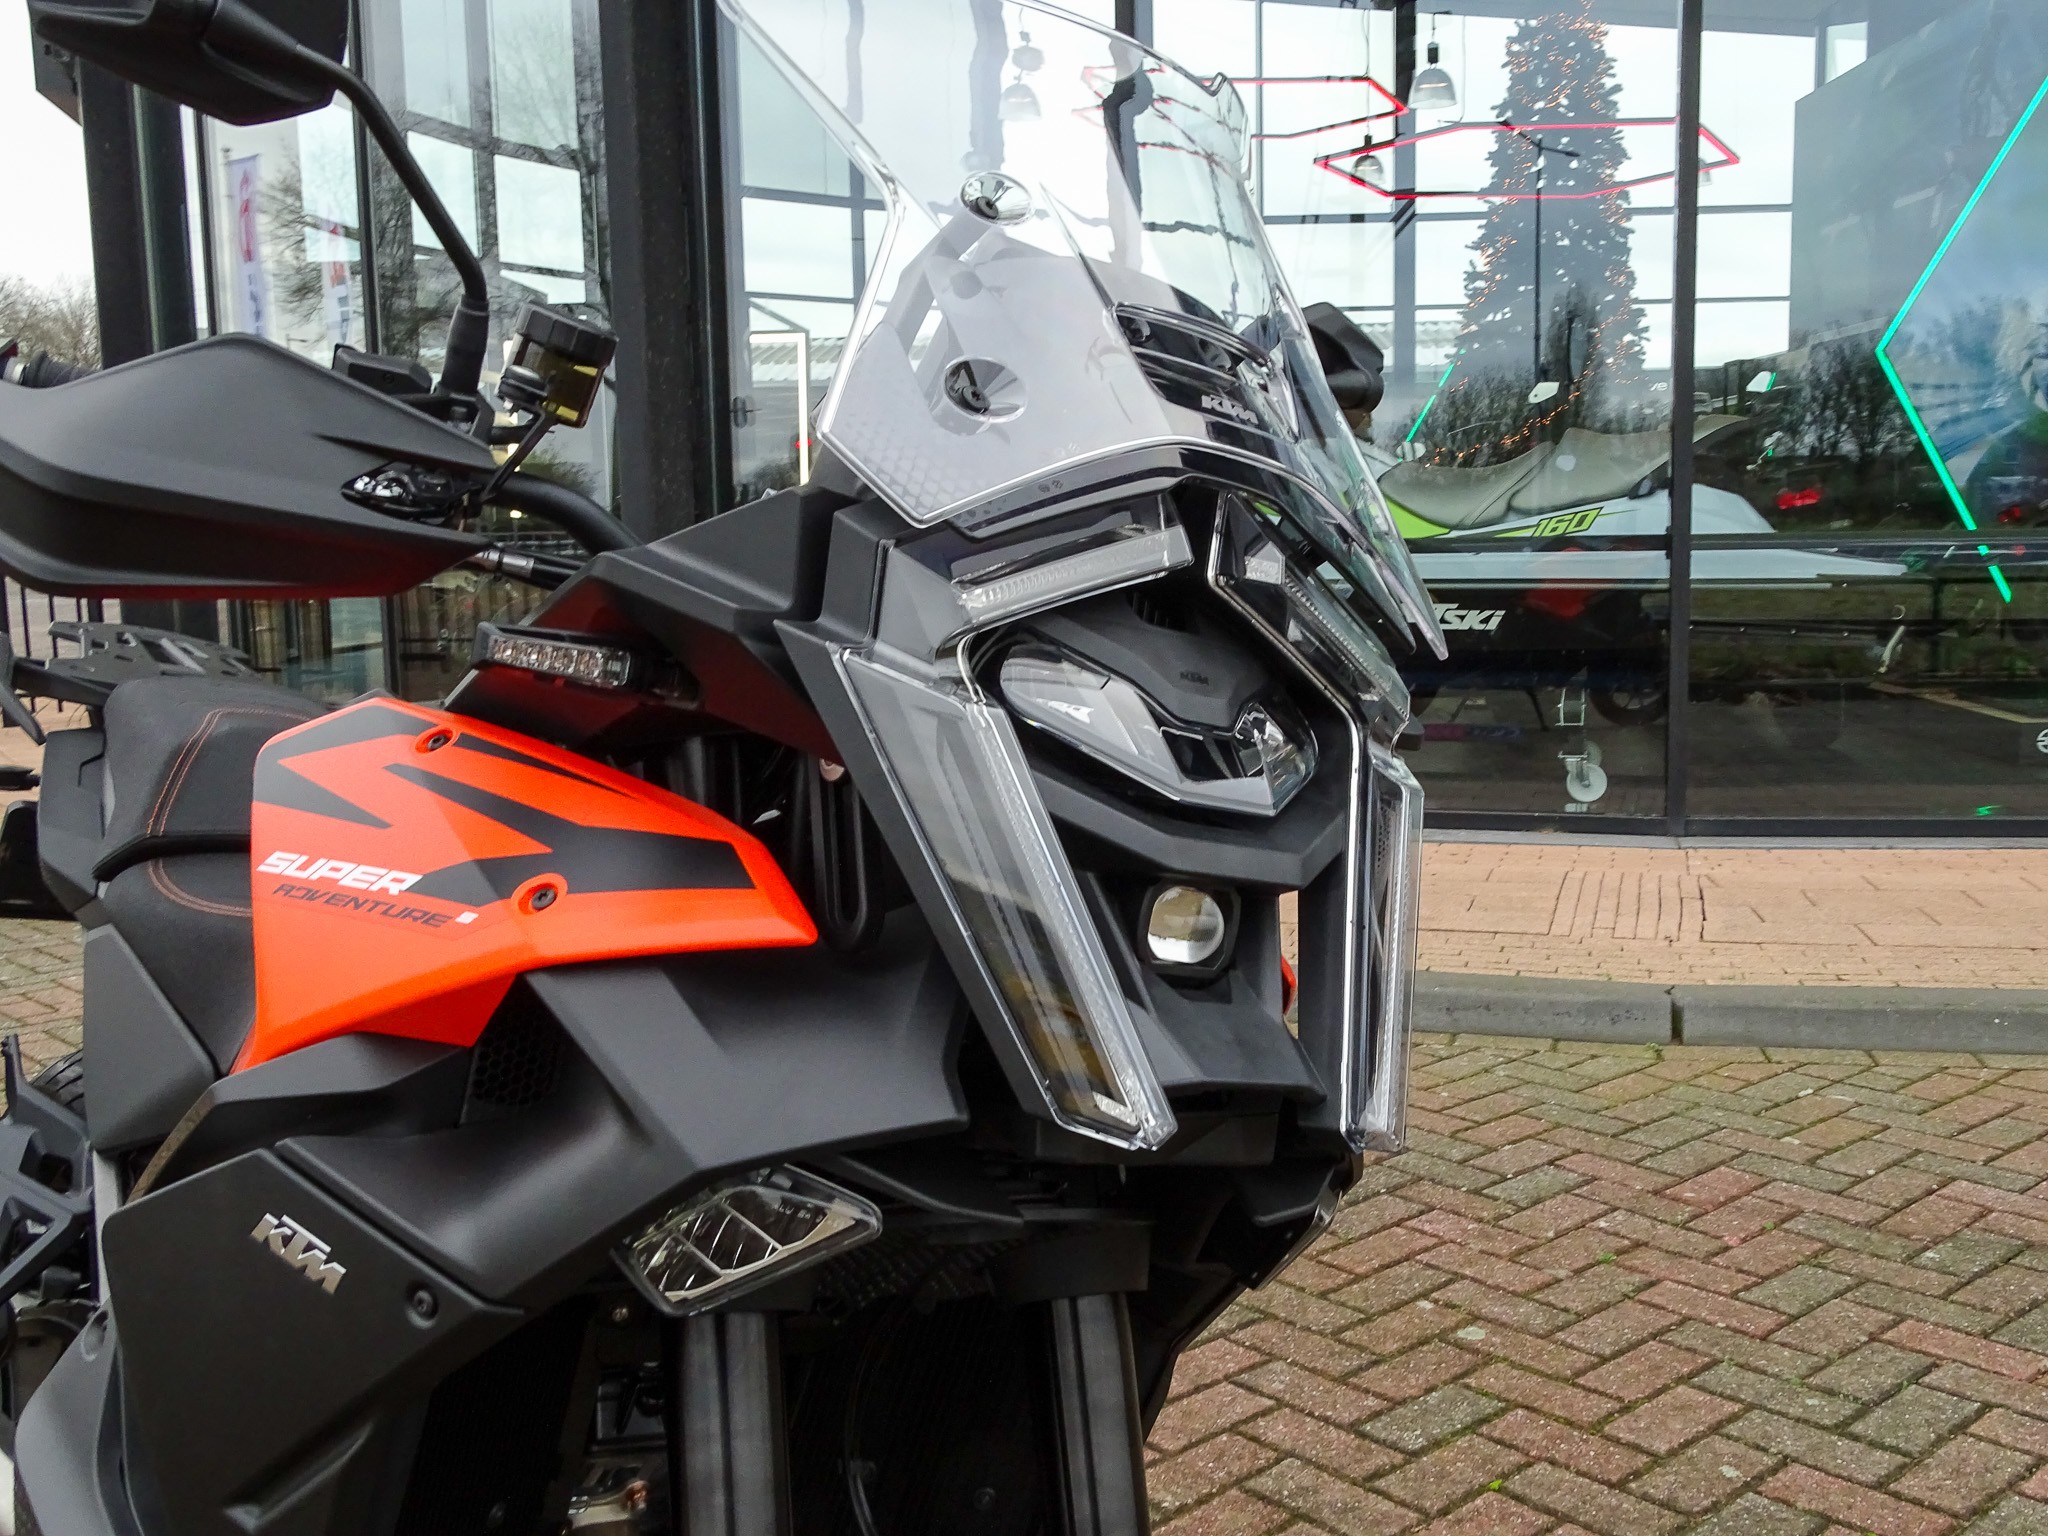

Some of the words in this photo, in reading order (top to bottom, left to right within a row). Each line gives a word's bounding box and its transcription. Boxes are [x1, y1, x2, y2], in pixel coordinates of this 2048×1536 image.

[1201, 394, 1259, 425] KTM
[1532, 508, 1602, 537] 160
[256, 850, 424, 896] SUPER
[272, 883, 453, 928] ADVENTURE
[250, 1212, 347, 1295] KTM
